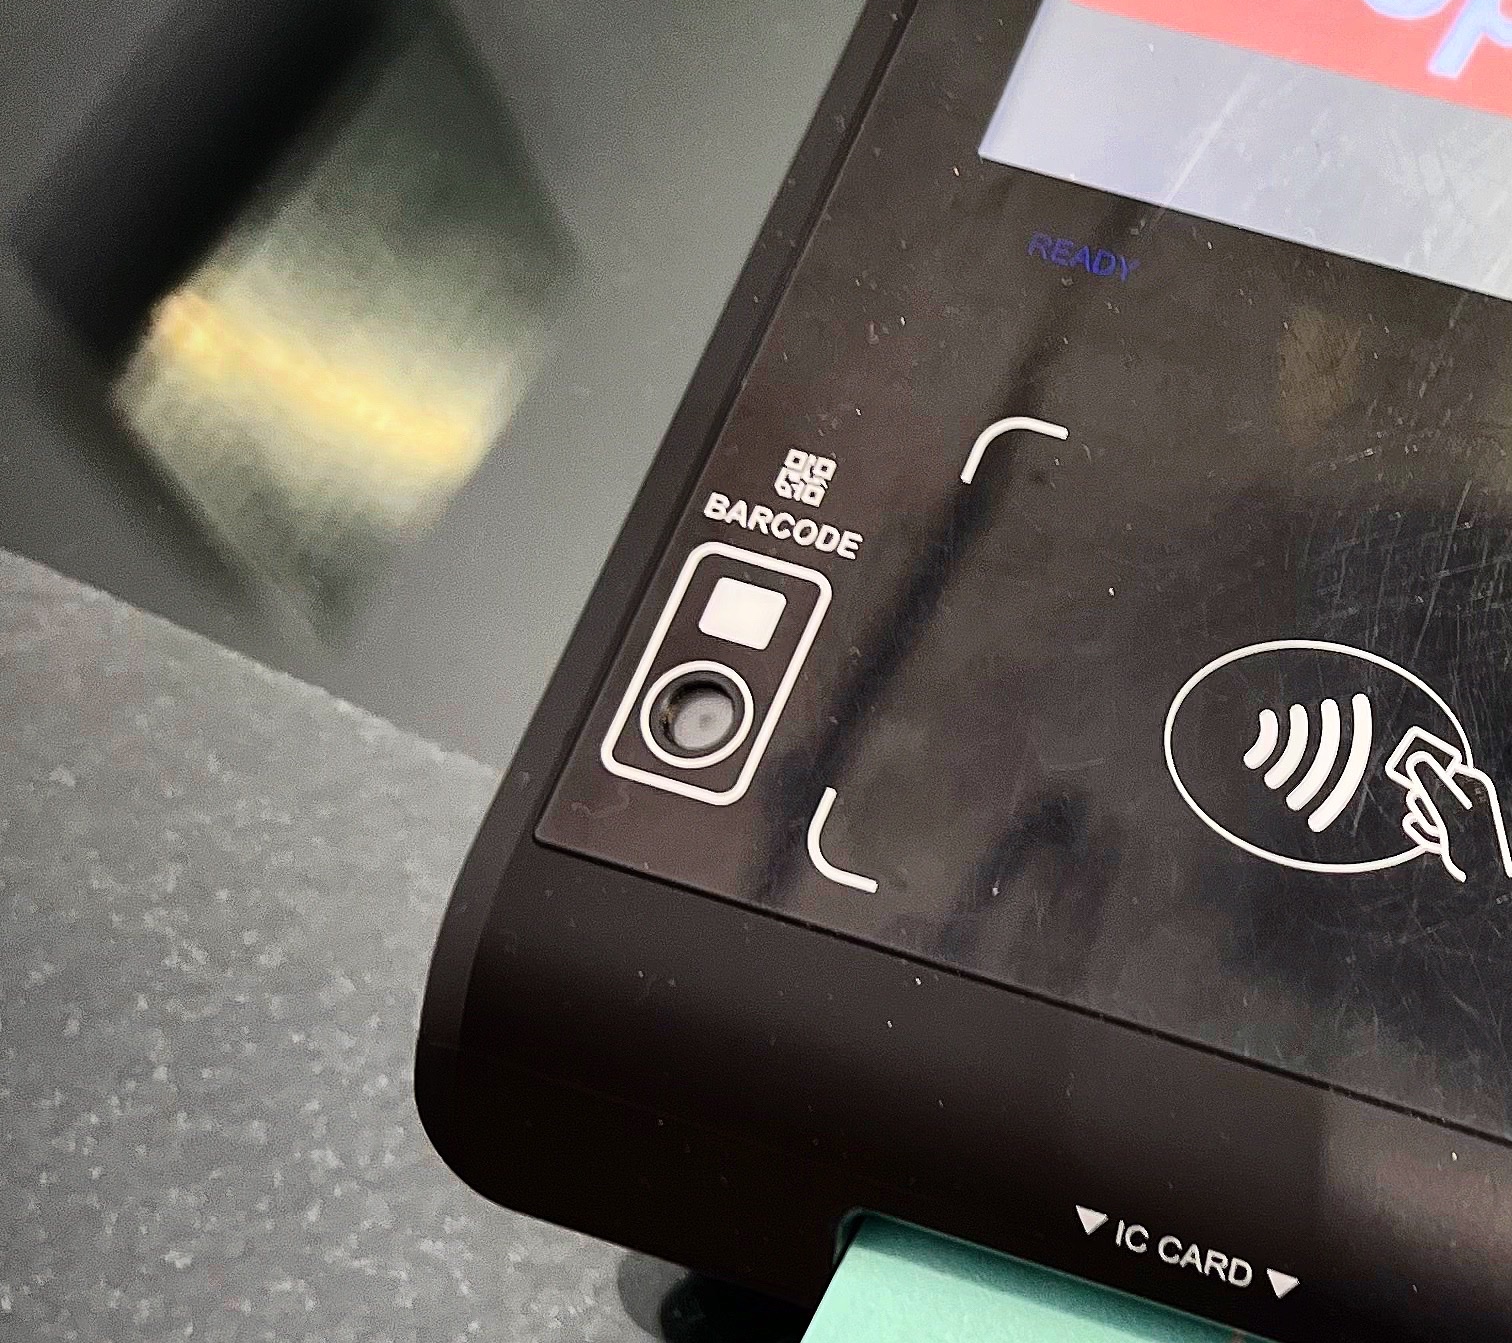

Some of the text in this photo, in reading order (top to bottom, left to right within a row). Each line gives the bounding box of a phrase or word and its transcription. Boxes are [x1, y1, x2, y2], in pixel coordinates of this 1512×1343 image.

[1027, 231, 1140, 283] READY
[703, 491, 864, 560] BARCODE
[1115, 1220, 1252, 1288] IC CARD
